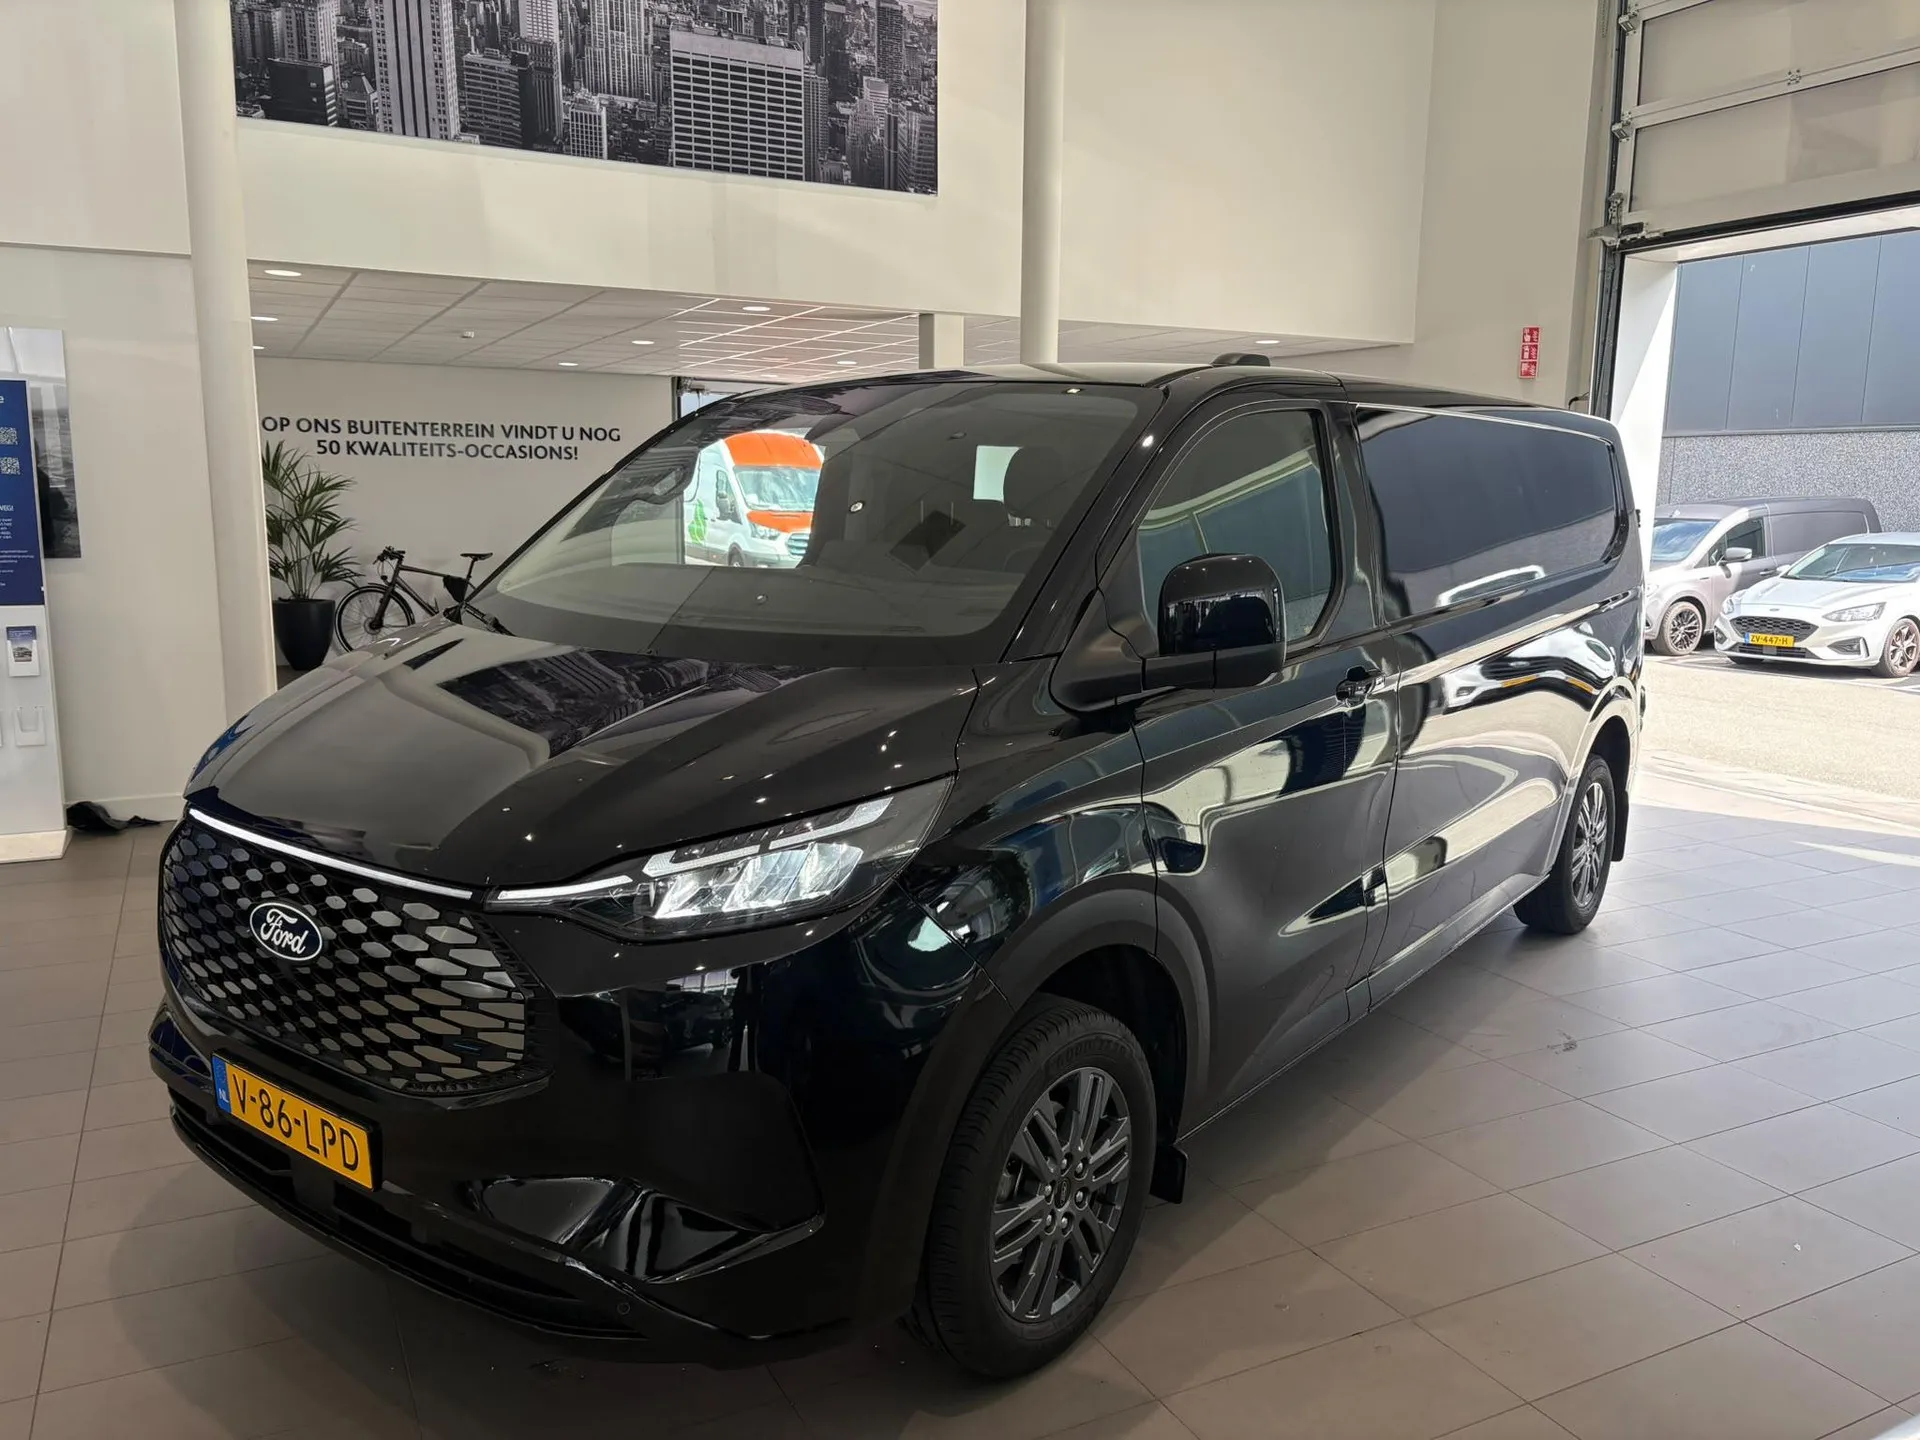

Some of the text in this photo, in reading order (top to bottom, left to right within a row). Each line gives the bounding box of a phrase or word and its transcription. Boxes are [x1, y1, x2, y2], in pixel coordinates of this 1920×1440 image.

[261, 416, 621, 442] OP ONS BUITENTERREIN VINDT U NOG
[316, 439, 579, 461] 50 KWALITEITS-OCCASIONS!
[259, 907, 310, 955] Ford
[232, 1072, 360, 1172] V-86-LPD
